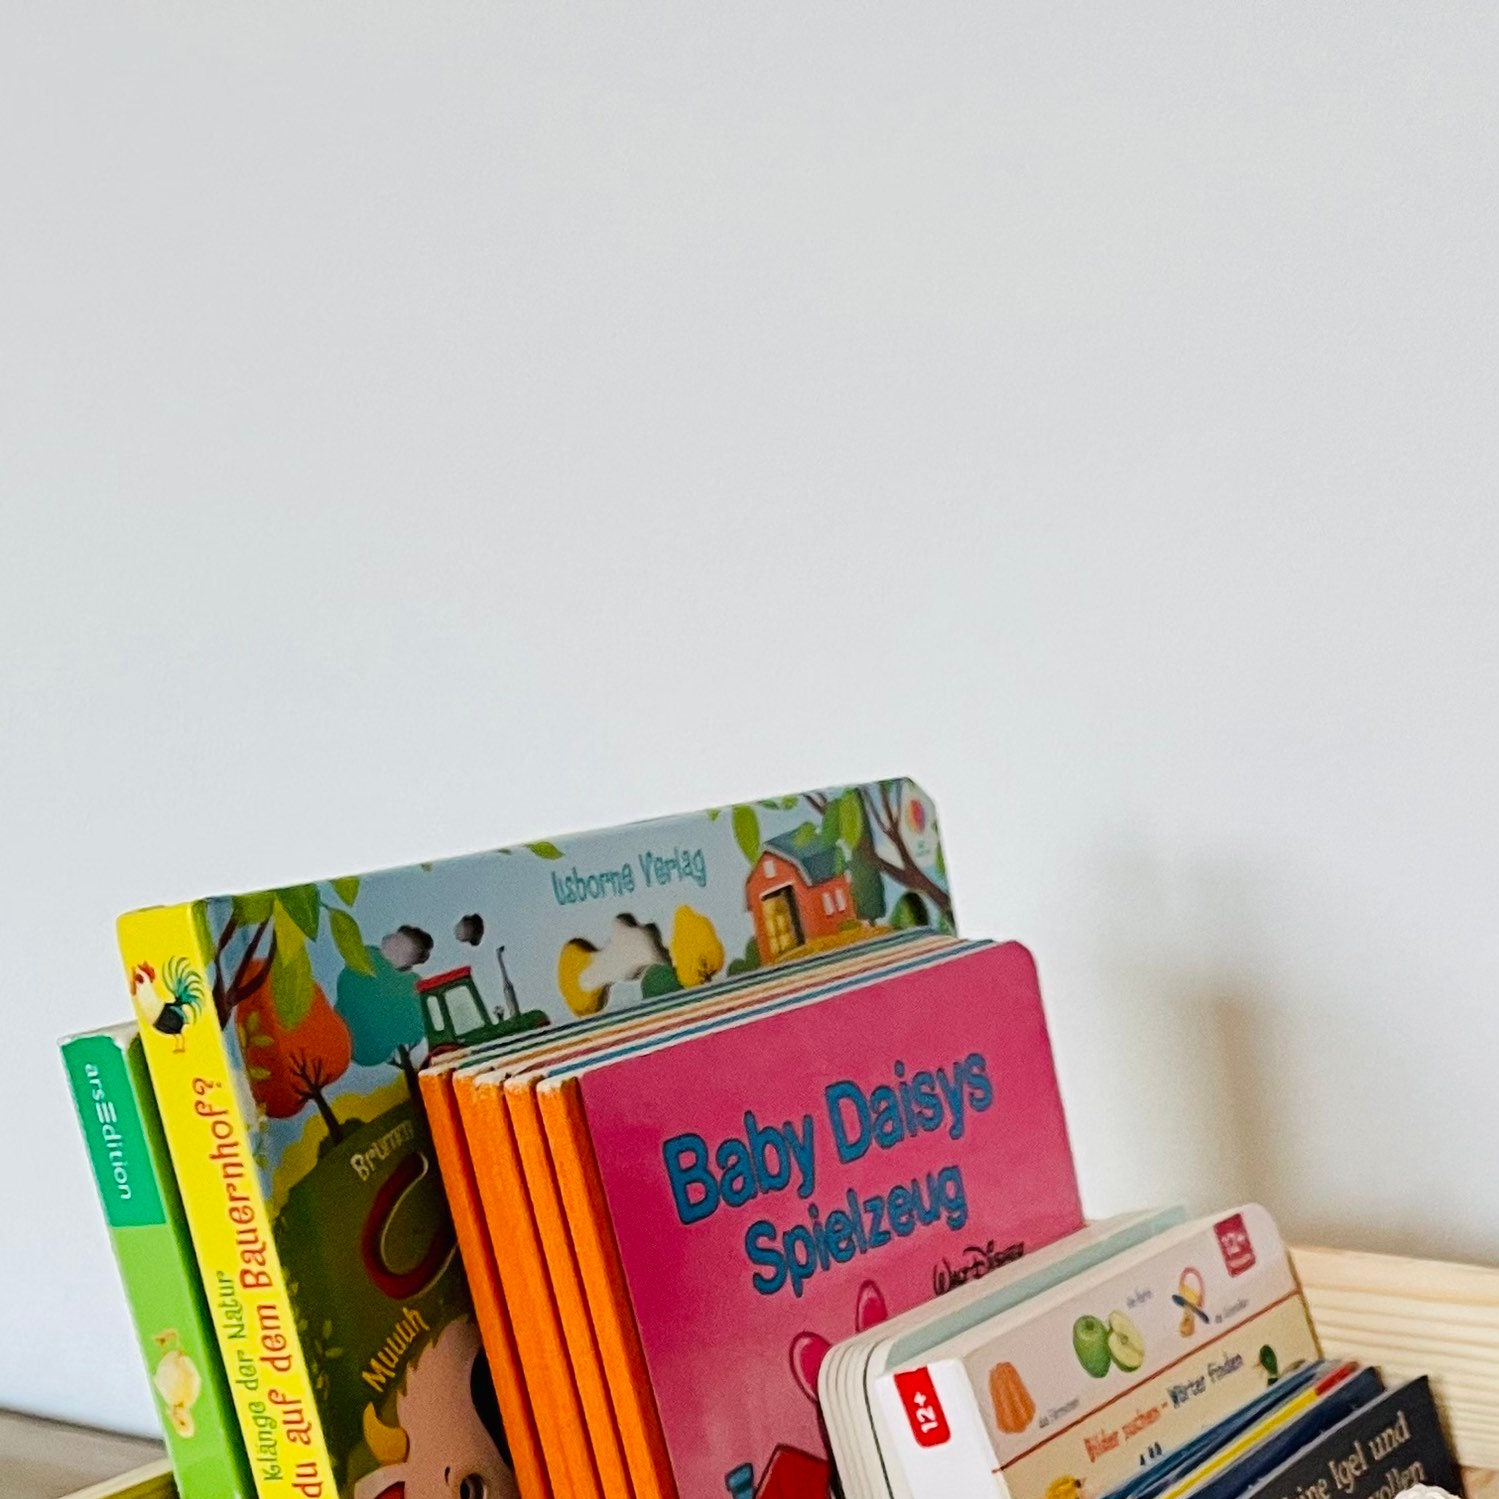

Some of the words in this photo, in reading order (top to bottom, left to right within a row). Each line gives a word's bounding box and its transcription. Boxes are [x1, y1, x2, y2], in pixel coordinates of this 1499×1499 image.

[638, 846, 707, 888] Verlag
[84, 1063, 132, 1200] arsEdition
[662, 1110, 815, 1226] Baby
[823, 1052, 993, 1164] Daisys
[191, 1077, 273, 1291] Bauernhof?
[744, 1165, 969, 1299] Spielzeug
[216, 1270, 247, 1341] Natur
[255, 1304, 292, 1373] dem
[235, 1350, 260, 1391] der
[248, 1400, 284, 1482] Klänge
[268, 1388, 311, 1446] auf
[912, 1391, 939, 1434] 12+
[291, 1461, 323, 1498] du
[1327, 1440, 1369, 1495] Igel
[1366, 1410, 1412, 1462] und
